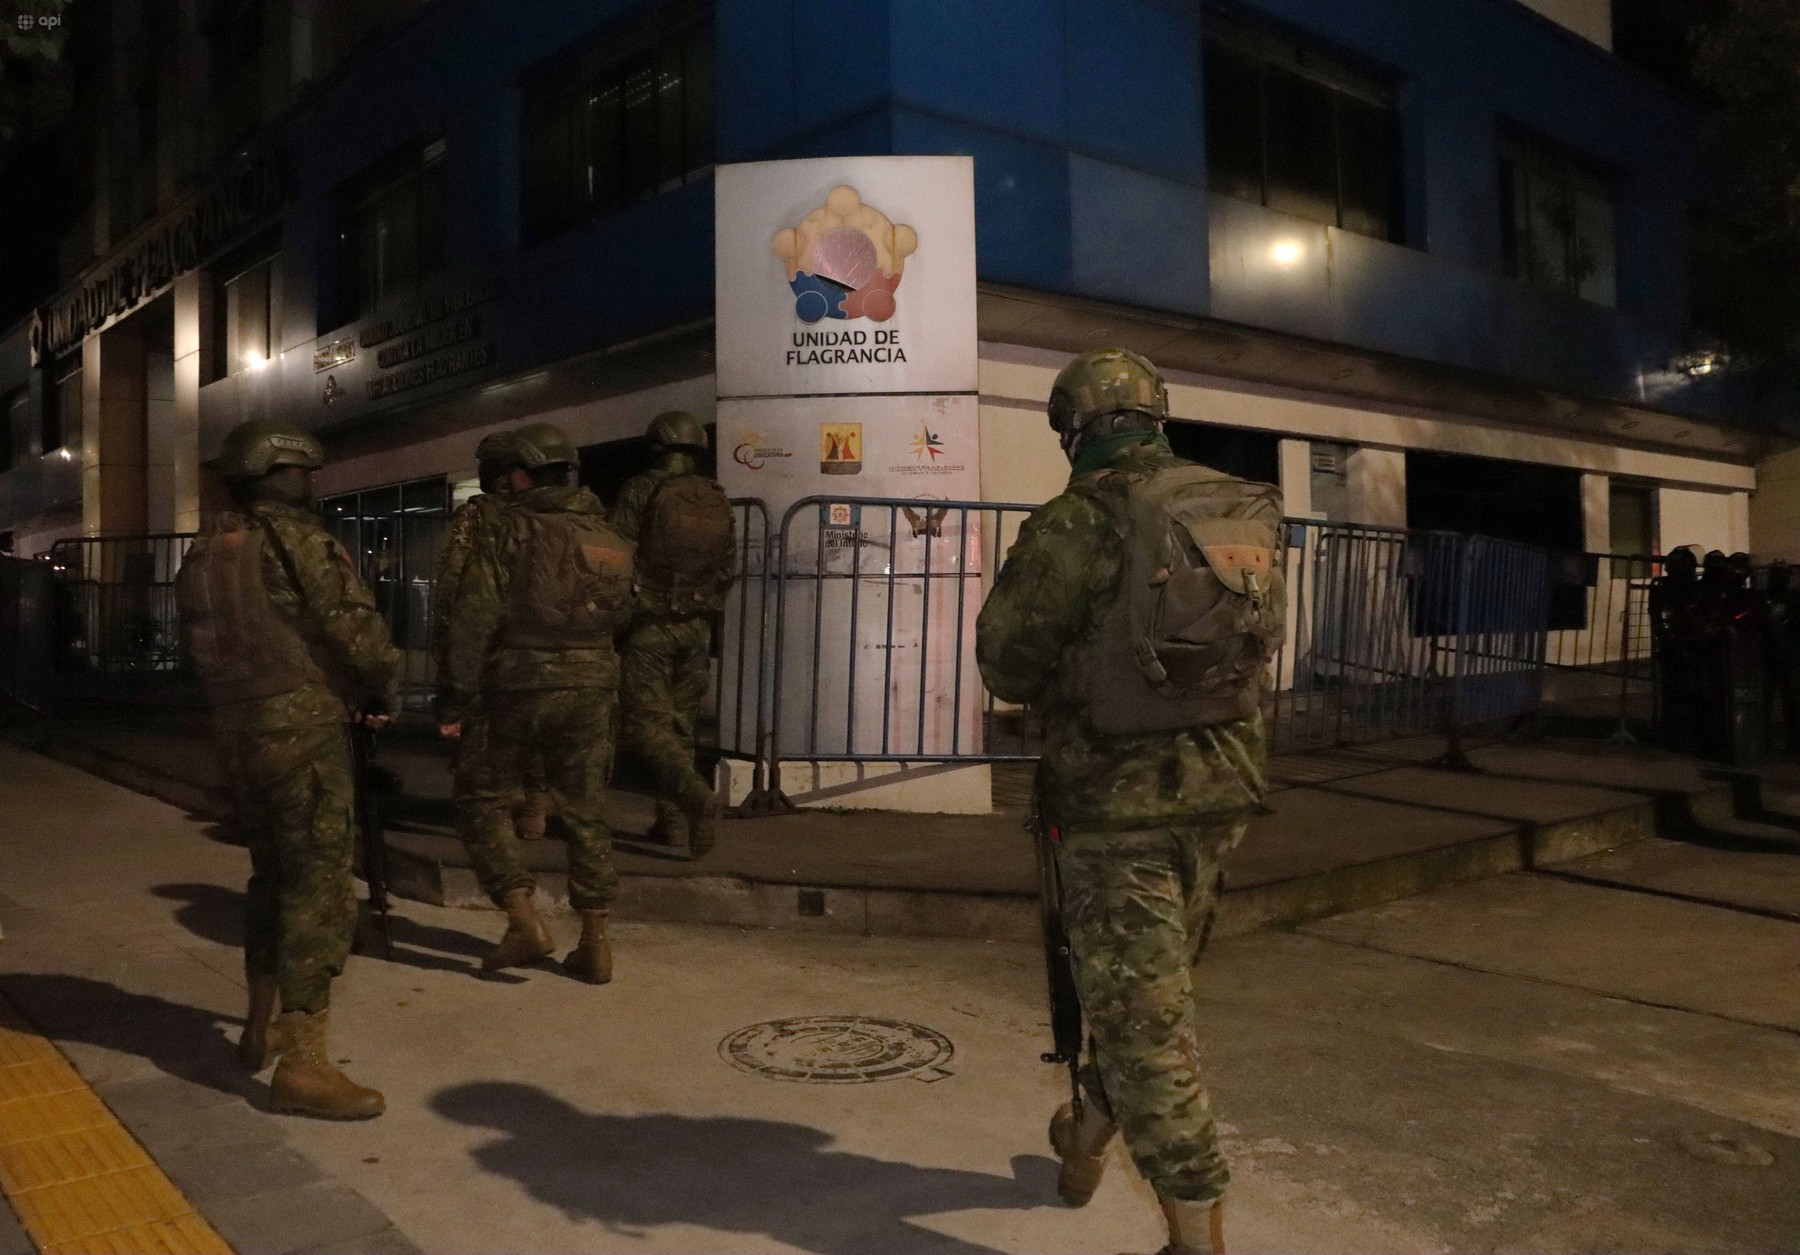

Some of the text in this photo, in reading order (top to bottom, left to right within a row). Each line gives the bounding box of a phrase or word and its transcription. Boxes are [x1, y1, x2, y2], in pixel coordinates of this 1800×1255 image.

[793, 329, 900, 347] UNIDAD DE
[786, 347, 907, 366] FLAGRANCIA
